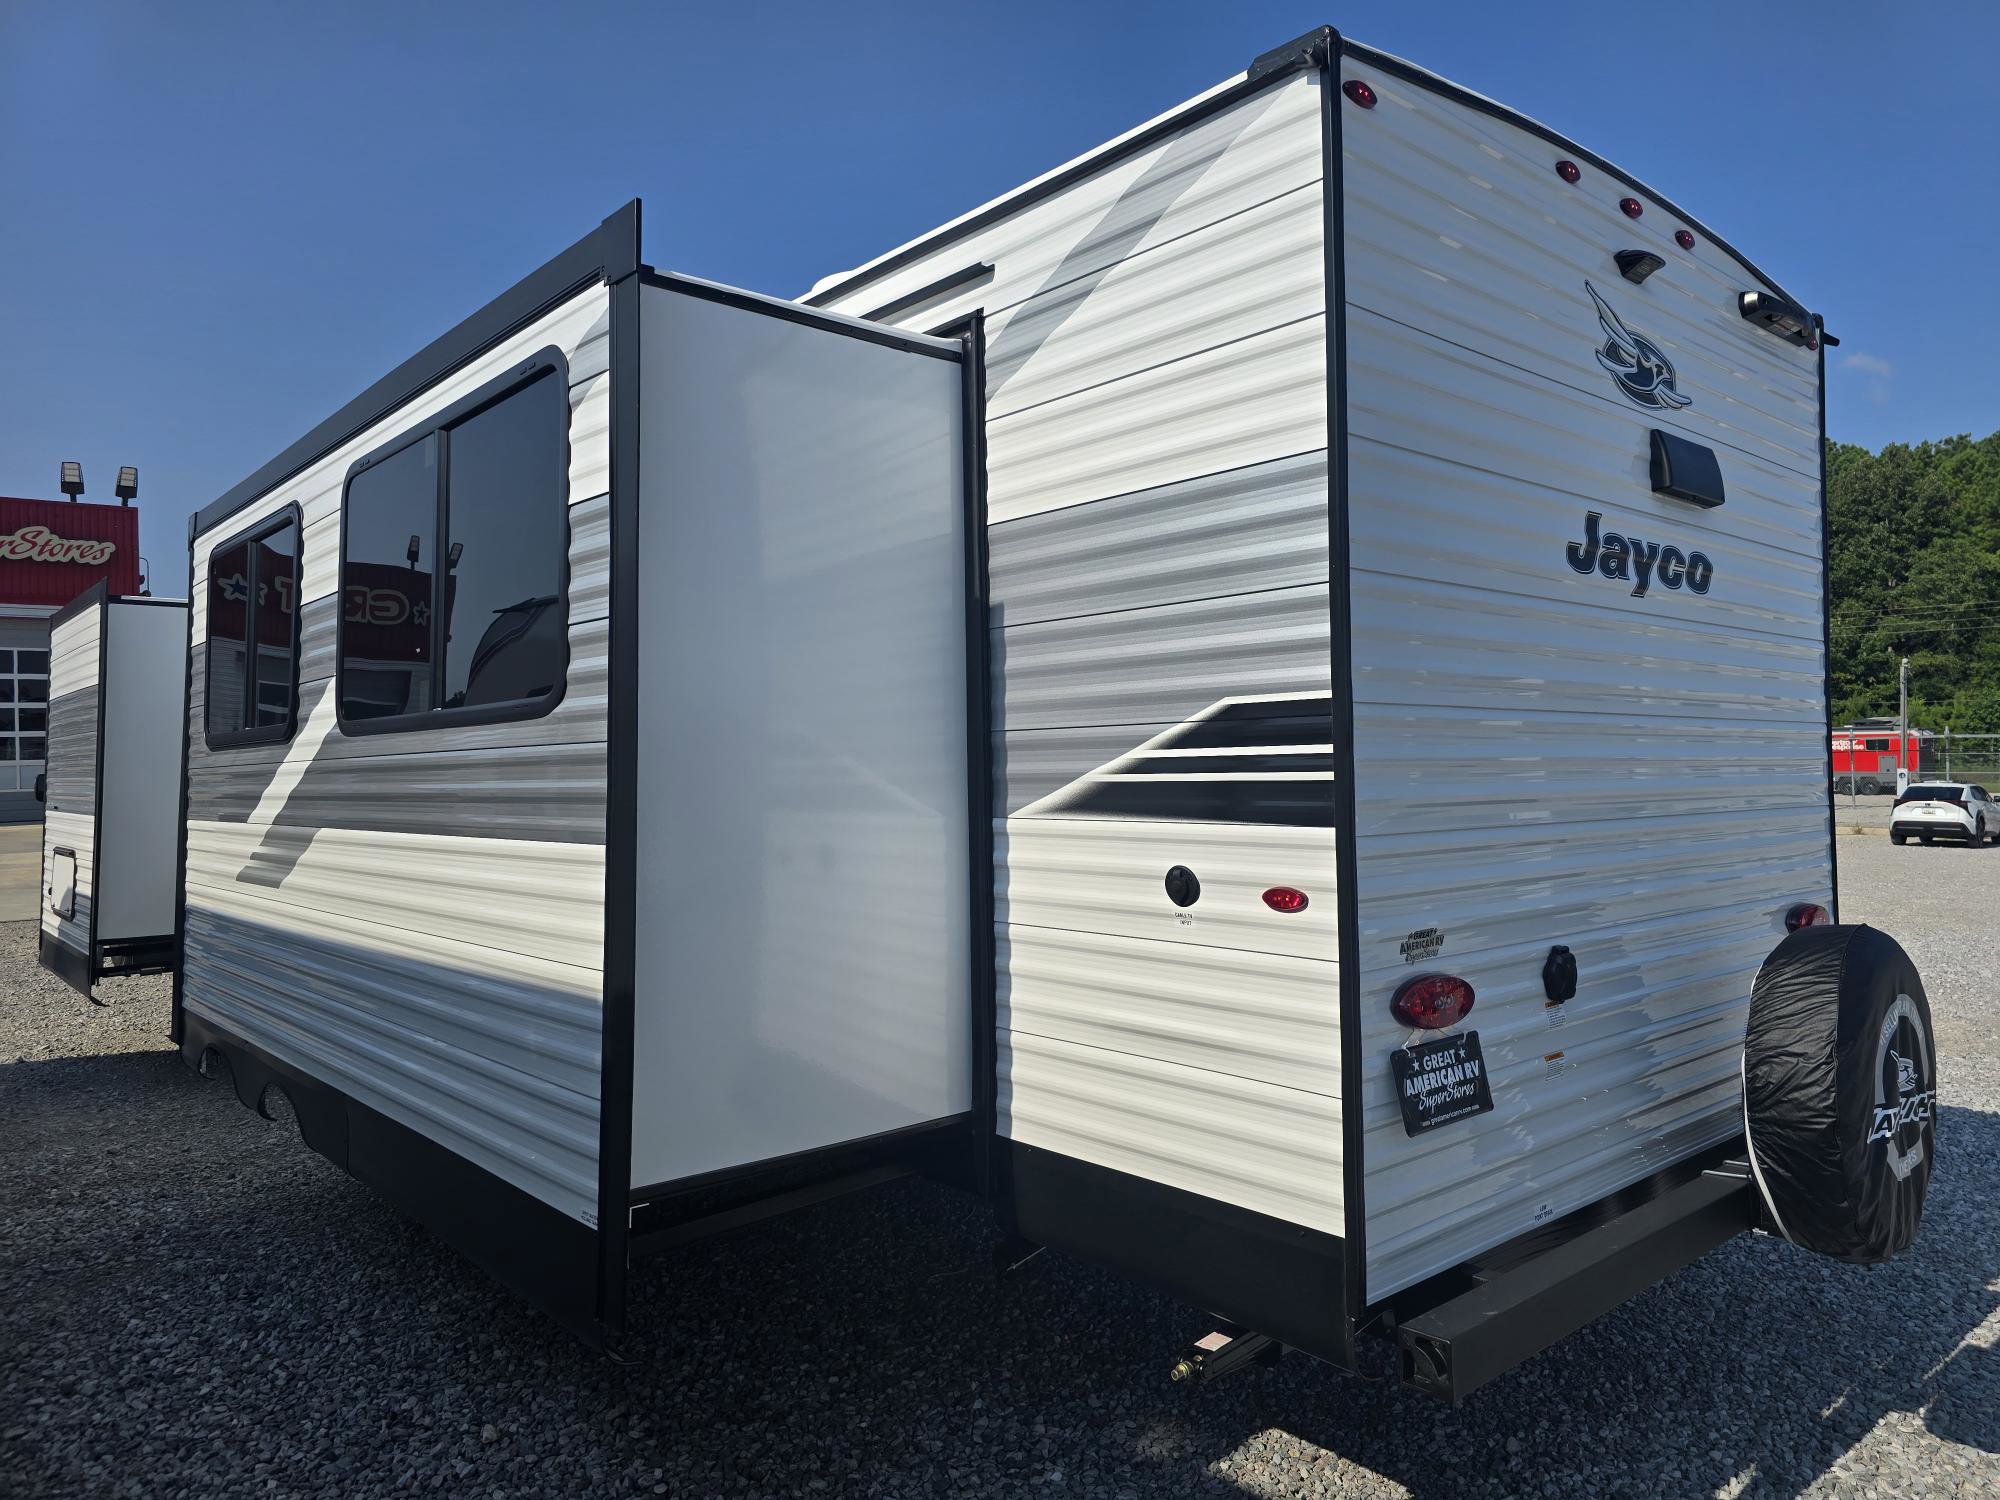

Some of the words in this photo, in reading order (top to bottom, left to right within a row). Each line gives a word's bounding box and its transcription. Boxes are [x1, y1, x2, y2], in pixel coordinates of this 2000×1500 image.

[0, 527, 114, 563] rStores
[1566, 511, 1714, 598] Jayco
[1400, 938, 1435, 955] AMERICAN
[1413, 928, 1434, 940] GREAT
[1423, 1048, 1456, 1071] GREAT
[1406, 1064, 1464, 1096] AMERICAN
[1464, 1060, 1480, 1078] RV
[1419, 1082, 1475, 1114] SuperStores
